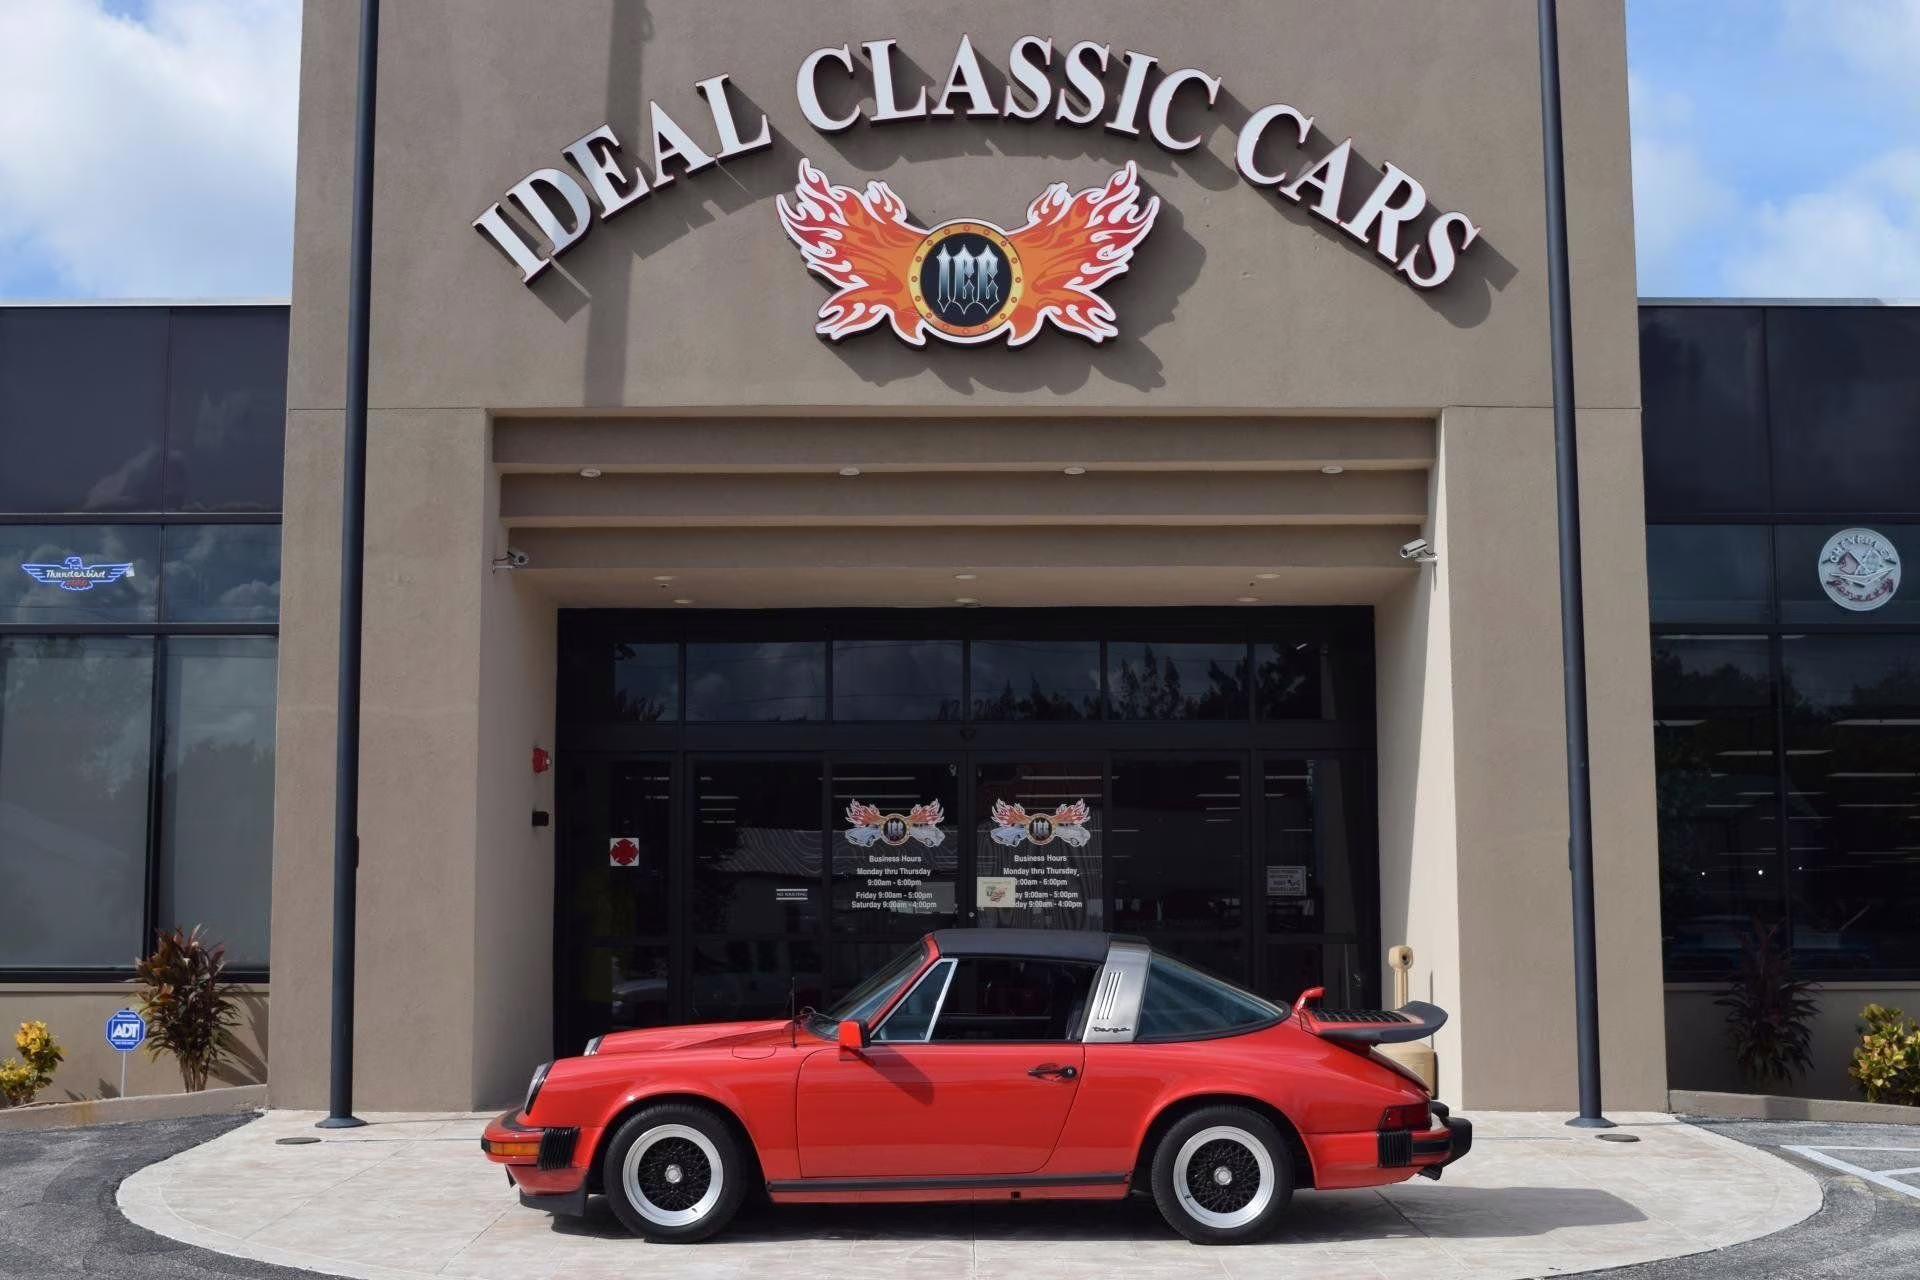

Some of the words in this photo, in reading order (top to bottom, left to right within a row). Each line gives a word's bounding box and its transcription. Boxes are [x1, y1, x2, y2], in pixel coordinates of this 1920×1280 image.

[472, 73, 772, 285] IDEAL
[795, 33, 1223, 153] CLASSIC
[1234, 103, 1482, 290] CARS
[46, 569, 106, 578] Thunderbird
[856, 868, 884, 876] Monday
[900, 868, 930, 876] Thursday
[1004, 868, 1028, 876] Monday
[1046, 868, 1078, 876] Thursday
[1044, 878, 1068, 886] 6:00pm
[856, 892, 876, 900] Friday
[908, 892, 932, 900] 5:00pm
[1054, 892, 1078, 900] 5:00pm
[852, 902, 880, 910] Saturday
[912, 902, 936, 910] 4:00pm
[1058, 900, 1082, 908] 4:00pm
[112, 1023, 139, 1038] ADT
